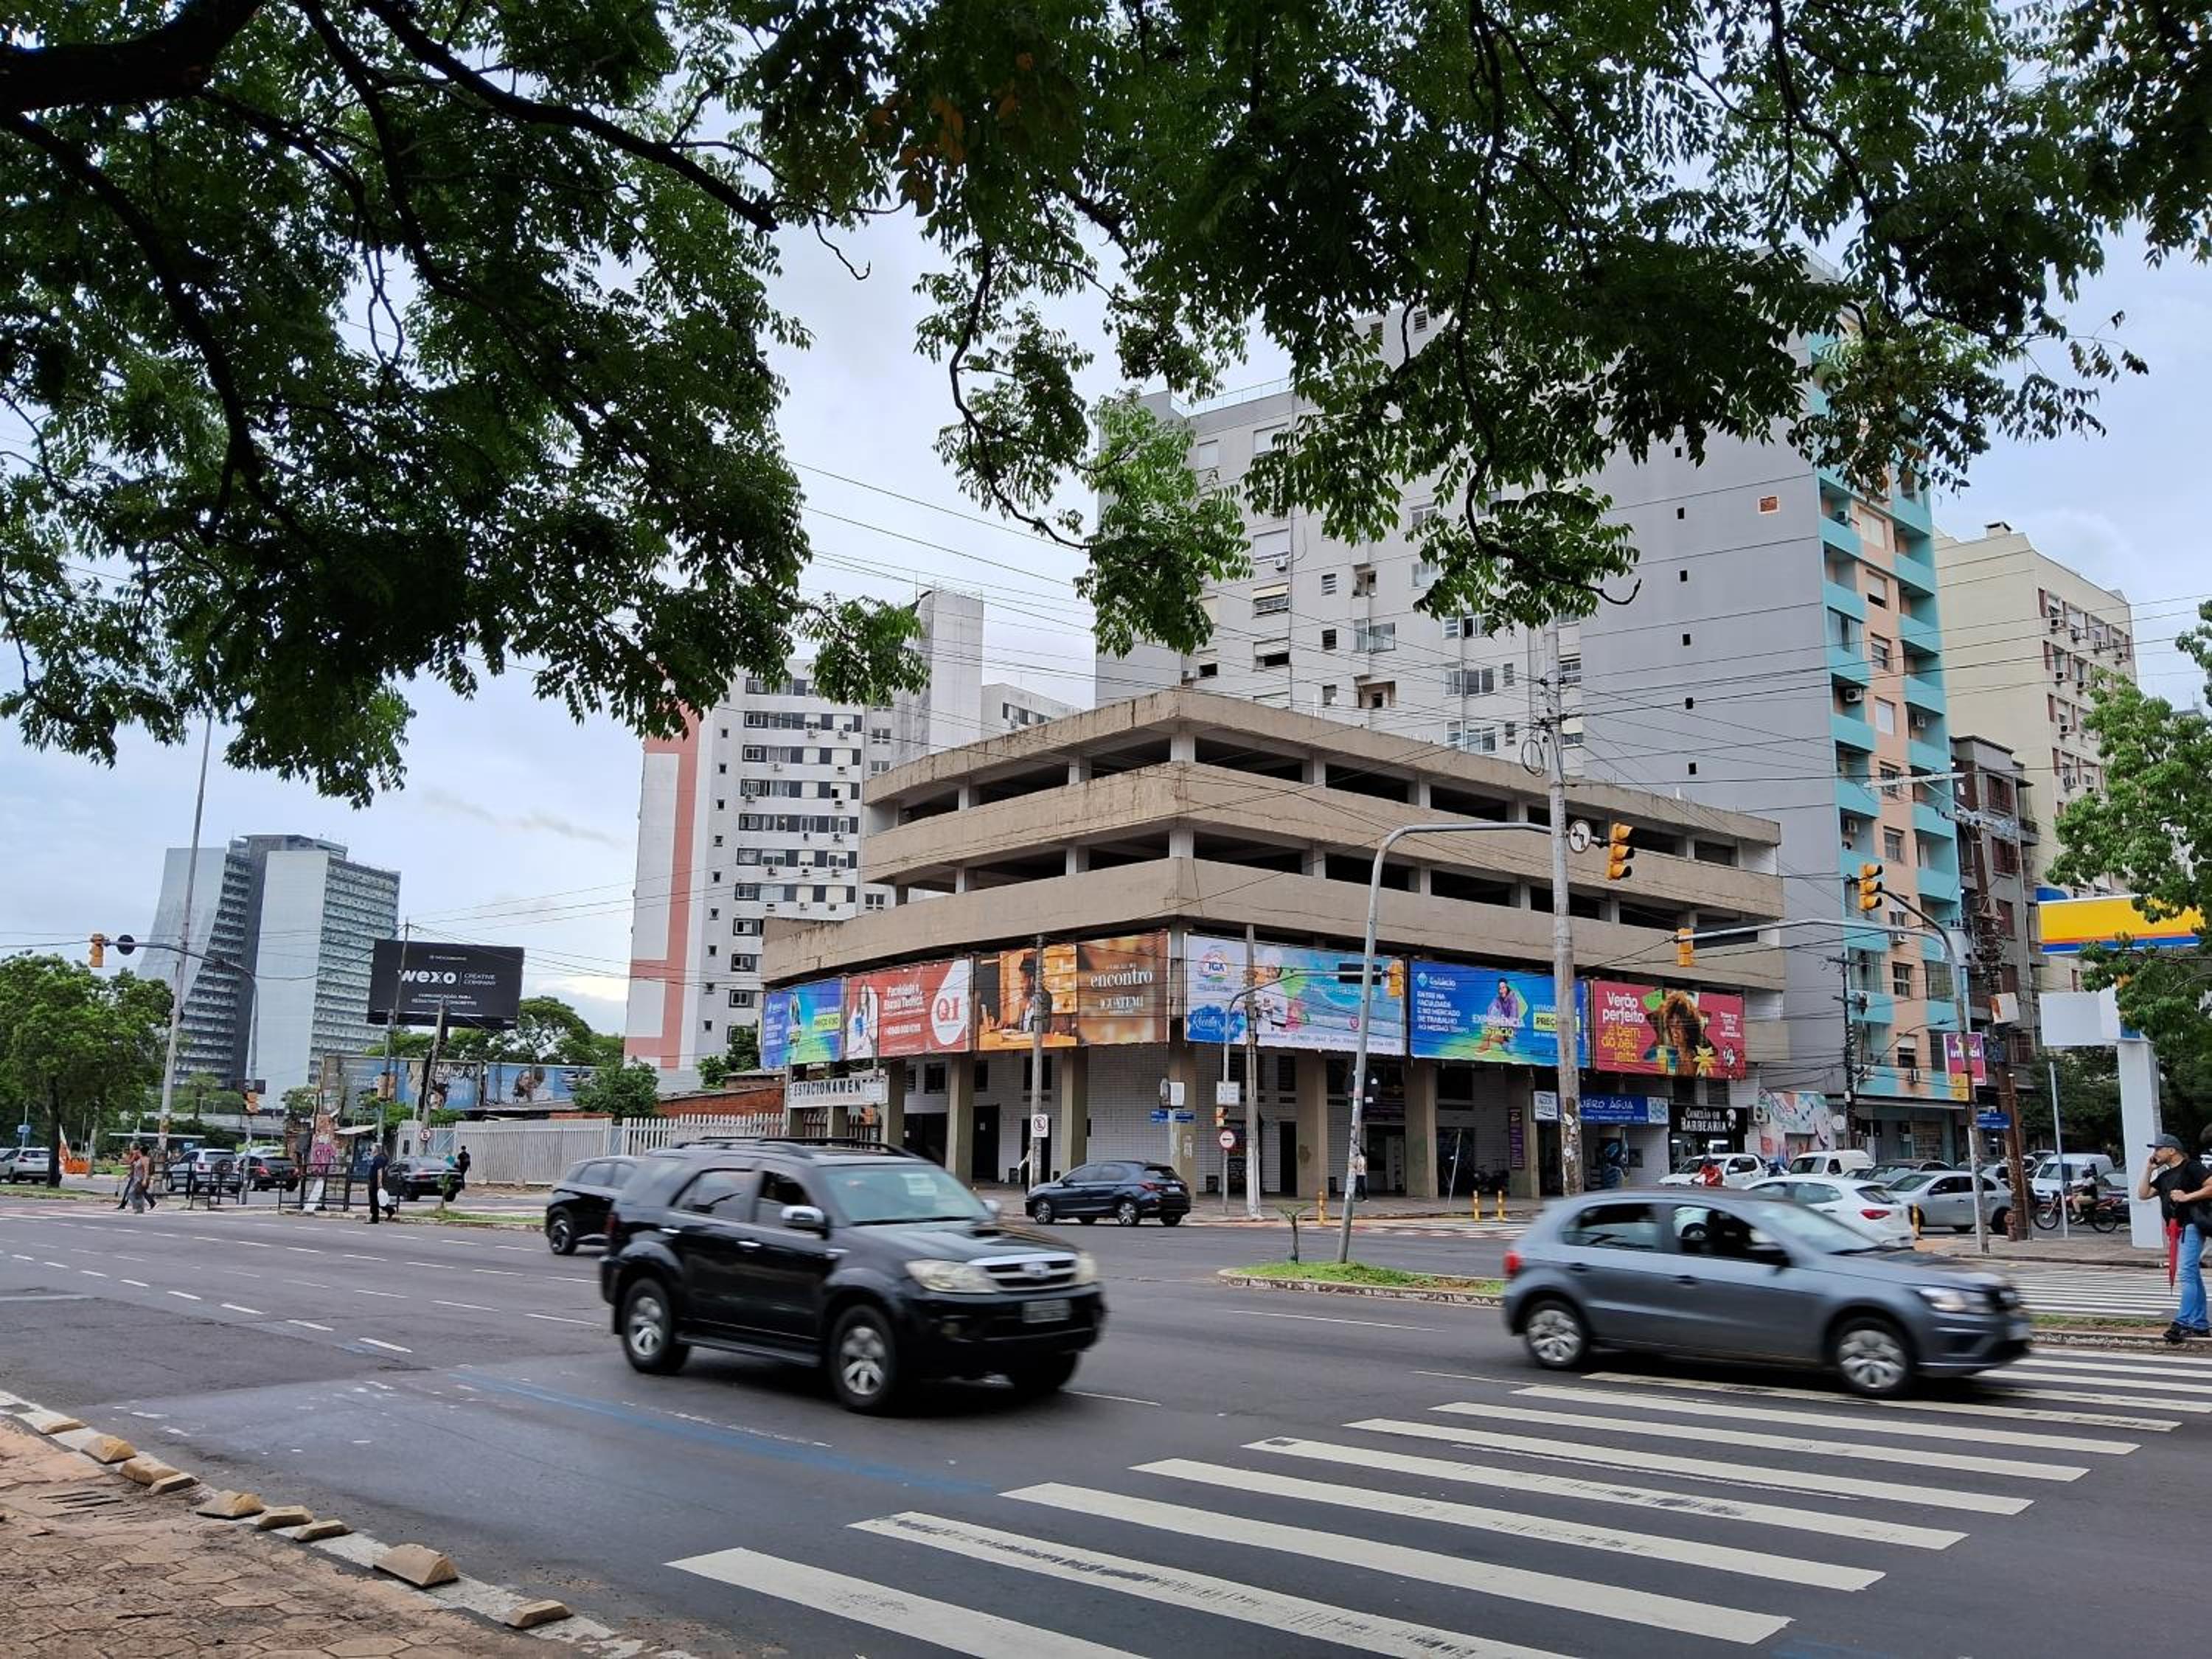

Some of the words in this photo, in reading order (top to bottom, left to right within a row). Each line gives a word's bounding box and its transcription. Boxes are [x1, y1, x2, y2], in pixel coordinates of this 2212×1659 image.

[397, 969, 456, 984] wexo
[1091, 968, 1152, 987] encontro
[1607, 990, 1638, 1009] Verão
[937, 996, 960, 1022] QI
[1602, 1007, 1646, 1025] perfeito
[1536, 1016, 1557, 1029] PREÇ
[793, 1078, 874, 1097] ESTACIONAMEN
[1609, 1096, 1635, 1110] ÁGUA
[1680, 1116, 1728, 1133] BARBEARIA
